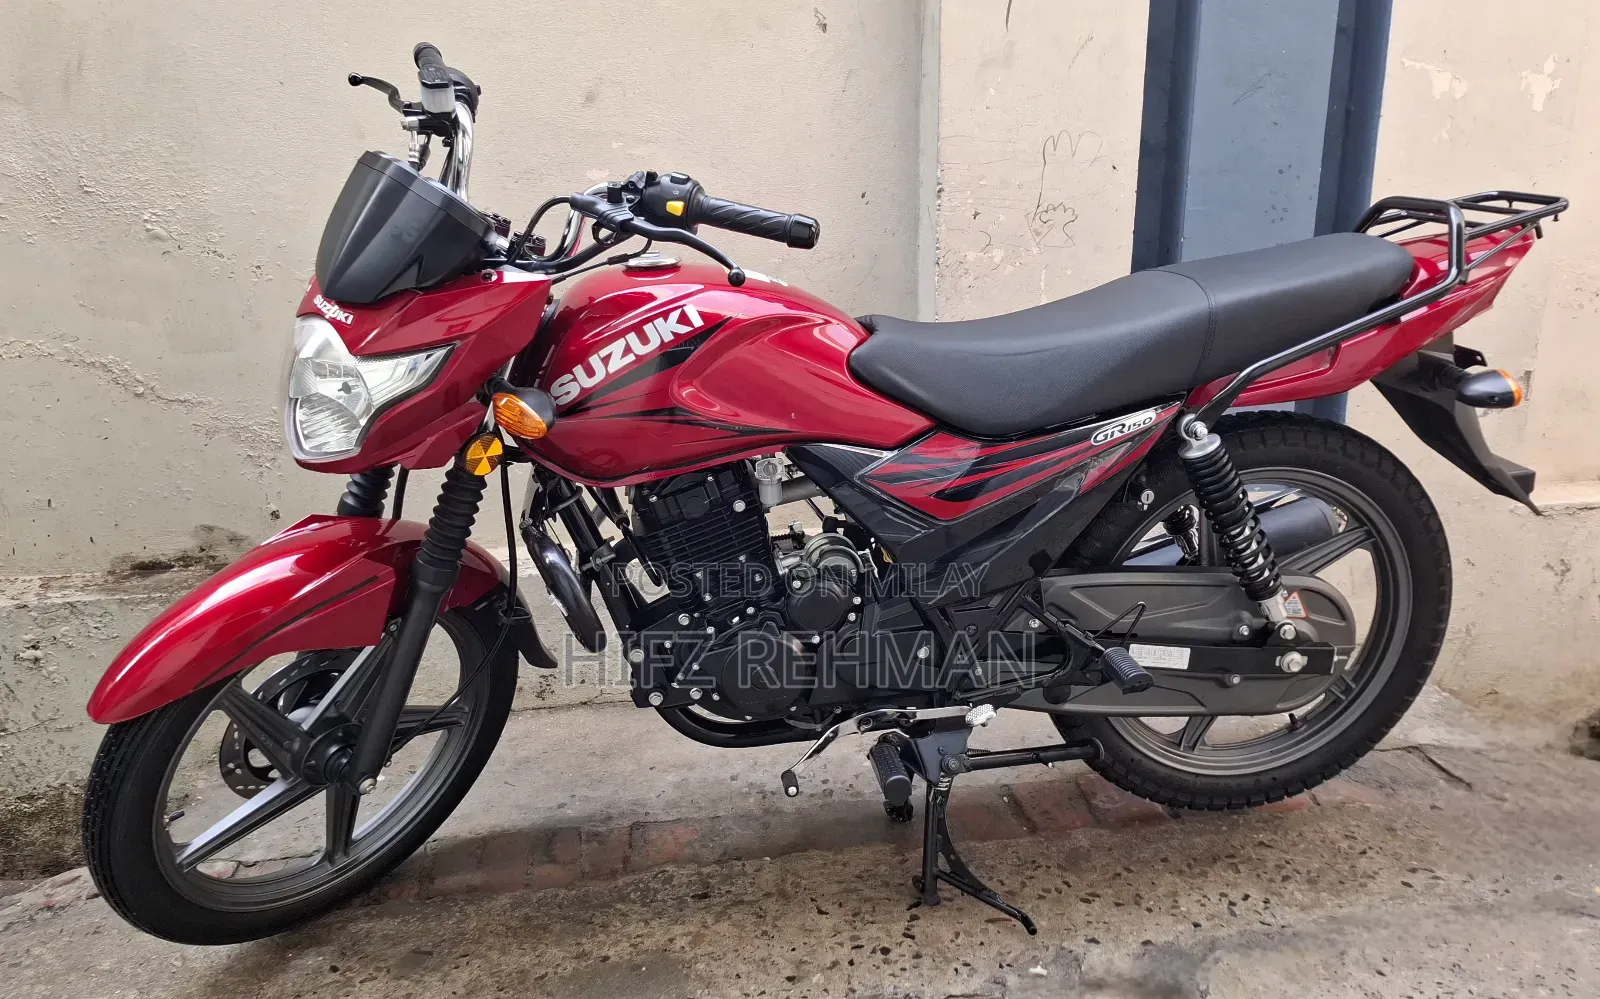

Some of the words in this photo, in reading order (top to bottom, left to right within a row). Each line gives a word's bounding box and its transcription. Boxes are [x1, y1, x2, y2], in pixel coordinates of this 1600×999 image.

[314, 294, 354, 325] SUZUKI
[550, 304, 704, 406] SUZUKI
[1093, 416, 1153, 443] GR150
